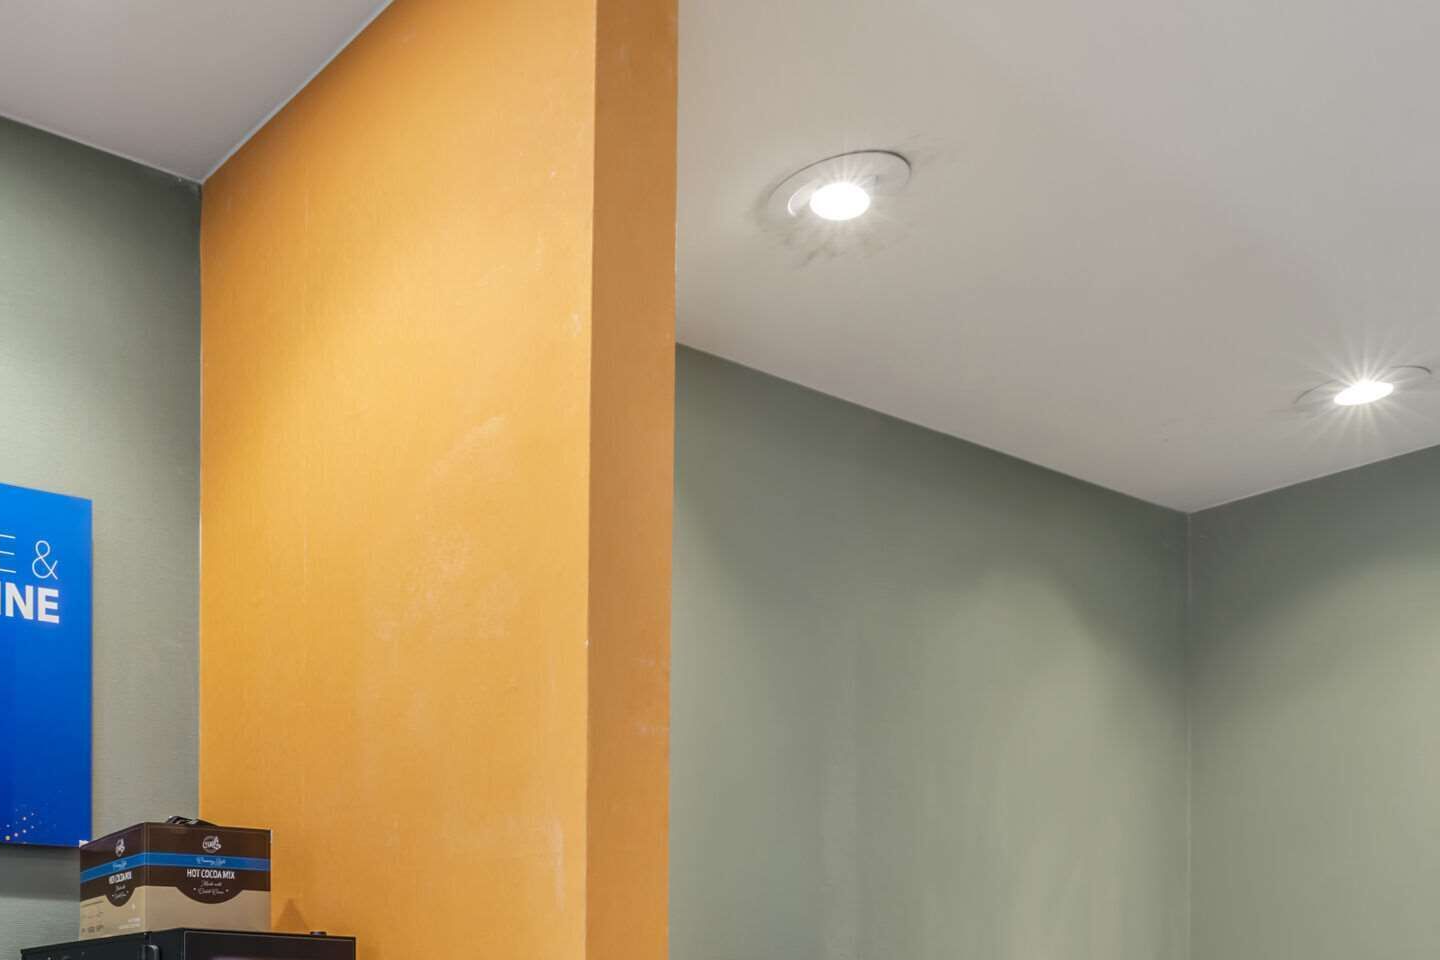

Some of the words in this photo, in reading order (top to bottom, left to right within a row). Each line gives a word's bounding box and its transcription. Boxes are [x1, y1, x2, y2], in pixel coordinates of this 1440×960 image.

[32, 540, 58, 580] &
[186, 868, 200, 878] HOT
[201, 869, 222, 879] COCOA
[222, 871, 235, 879] MIX
